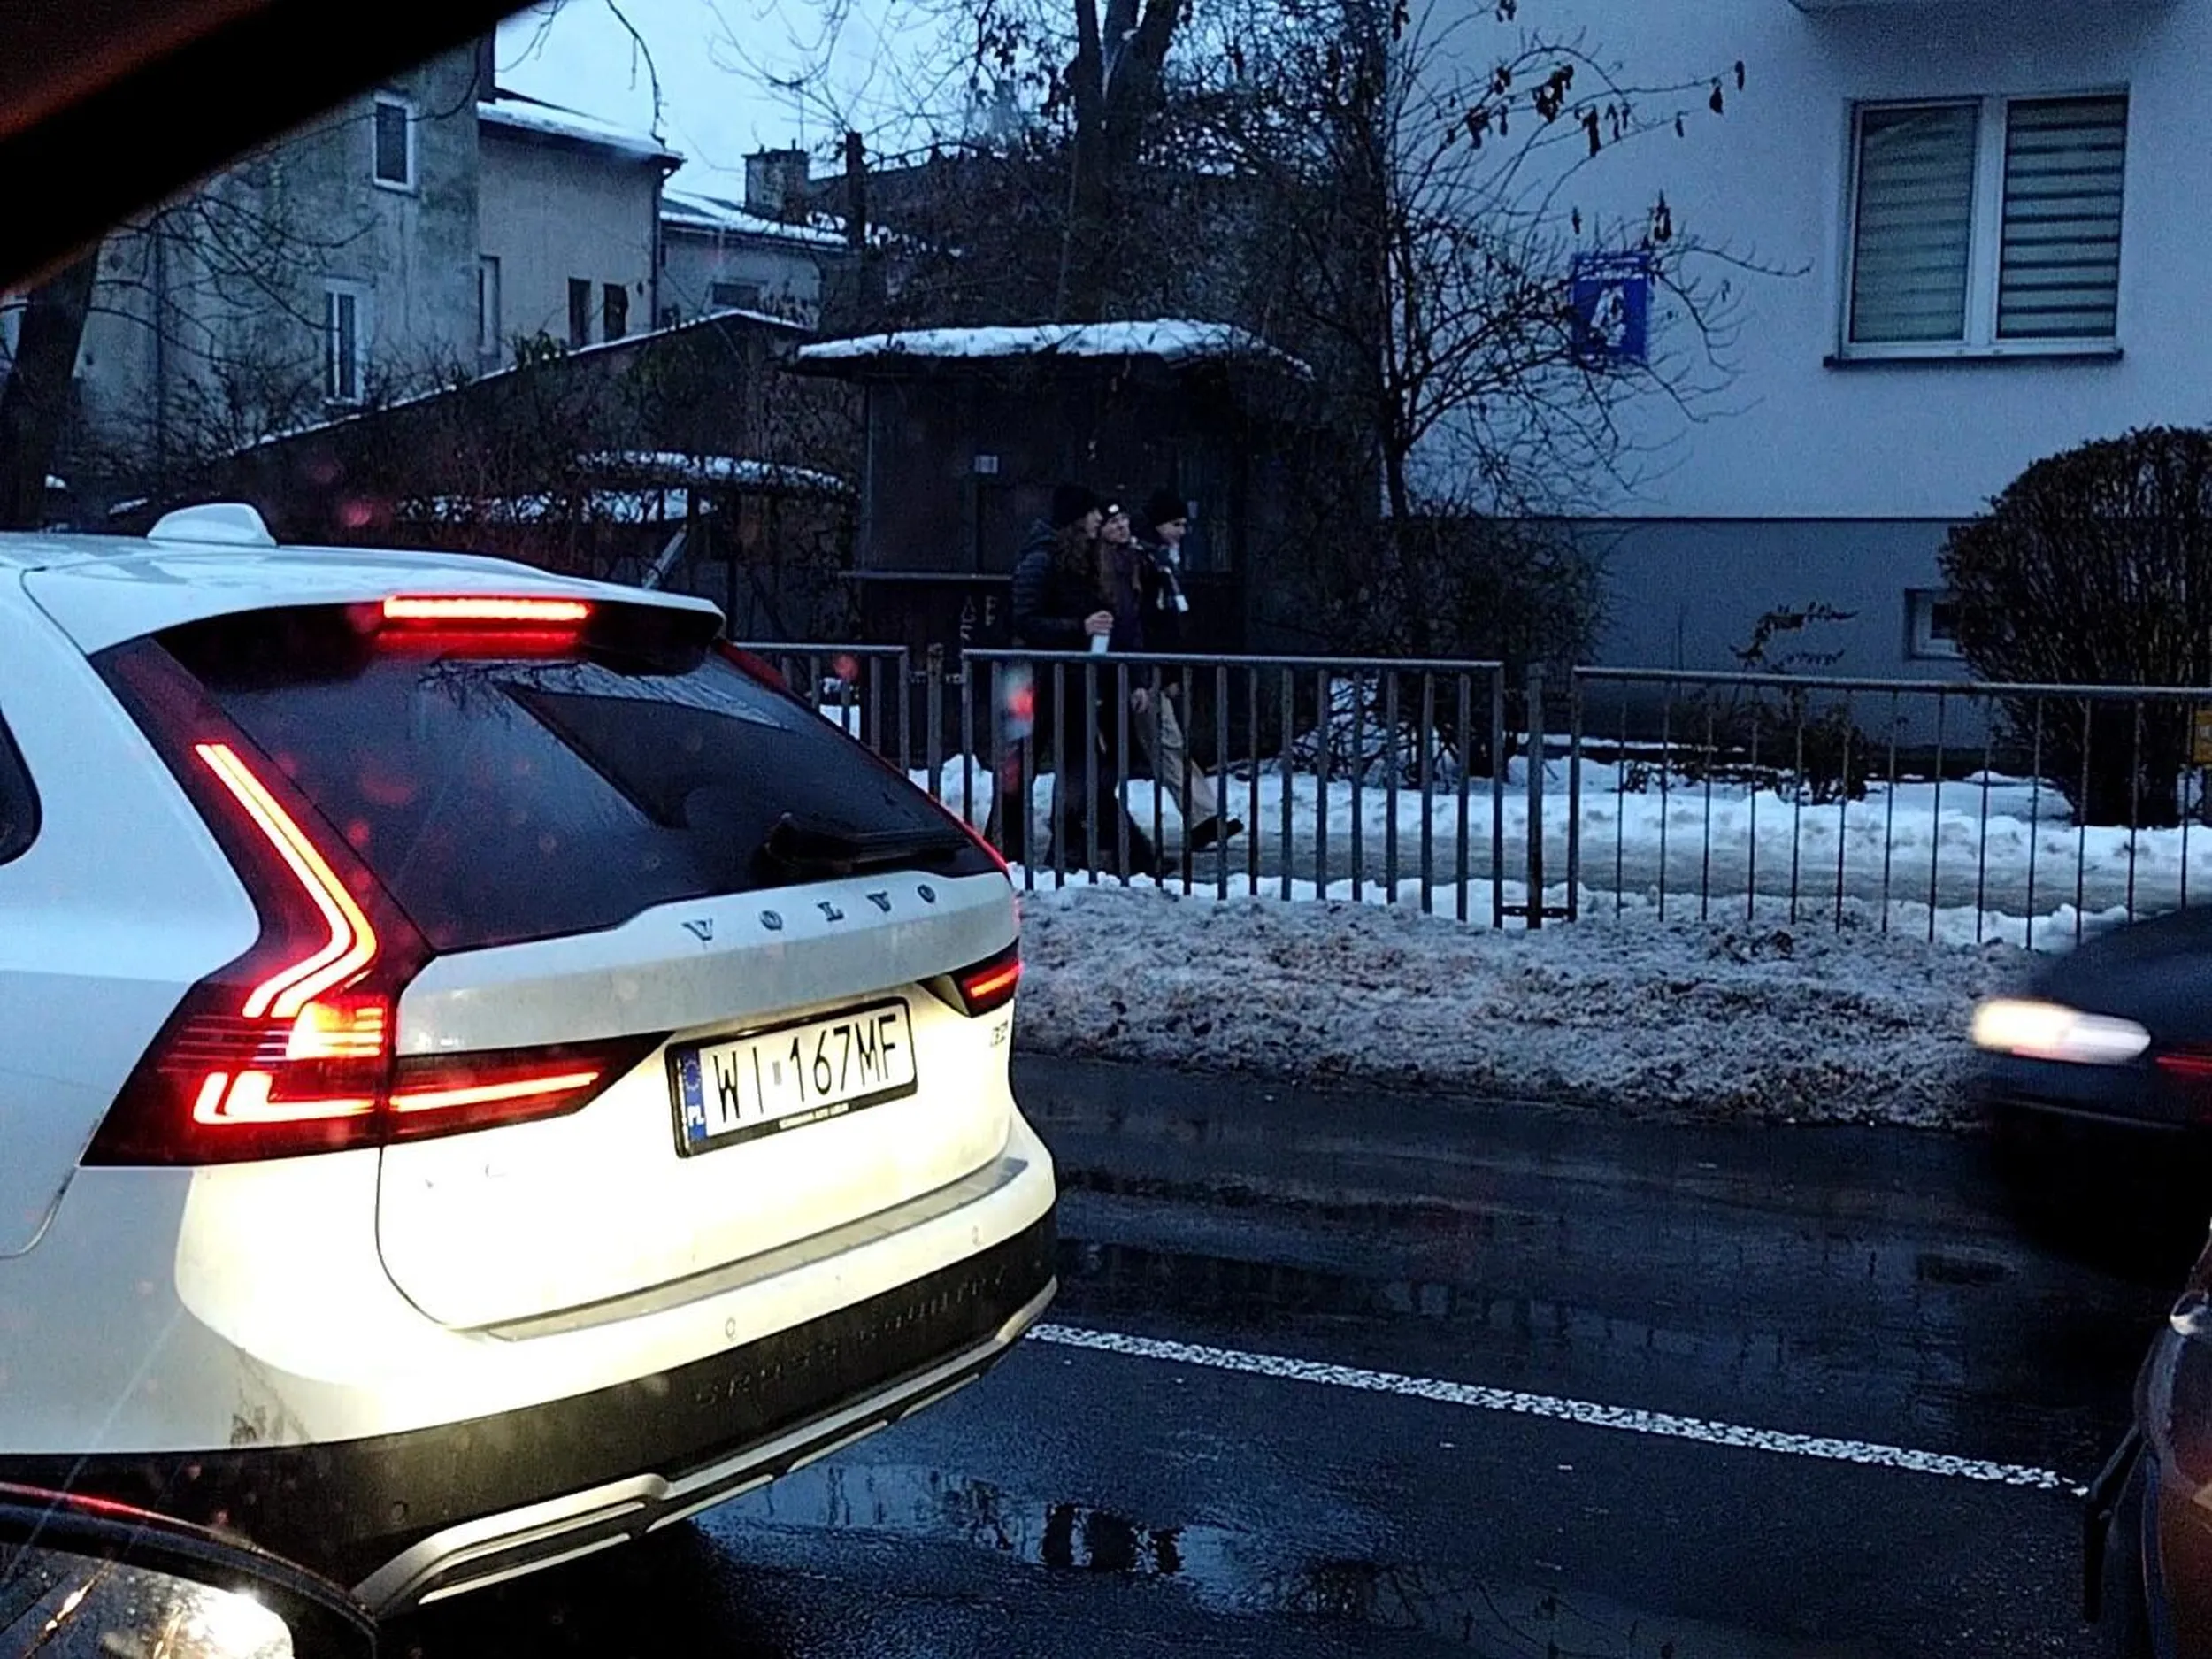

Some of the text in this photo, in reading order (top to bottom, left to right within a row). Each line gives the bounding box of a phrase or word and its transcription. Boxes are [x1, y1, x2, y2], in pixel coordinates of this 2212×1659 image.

[681, 883, 937, 942] VOLVO
[713, 1013, 897, 1123] WI 167MF
[687, 1105, 705, 1127] PL
